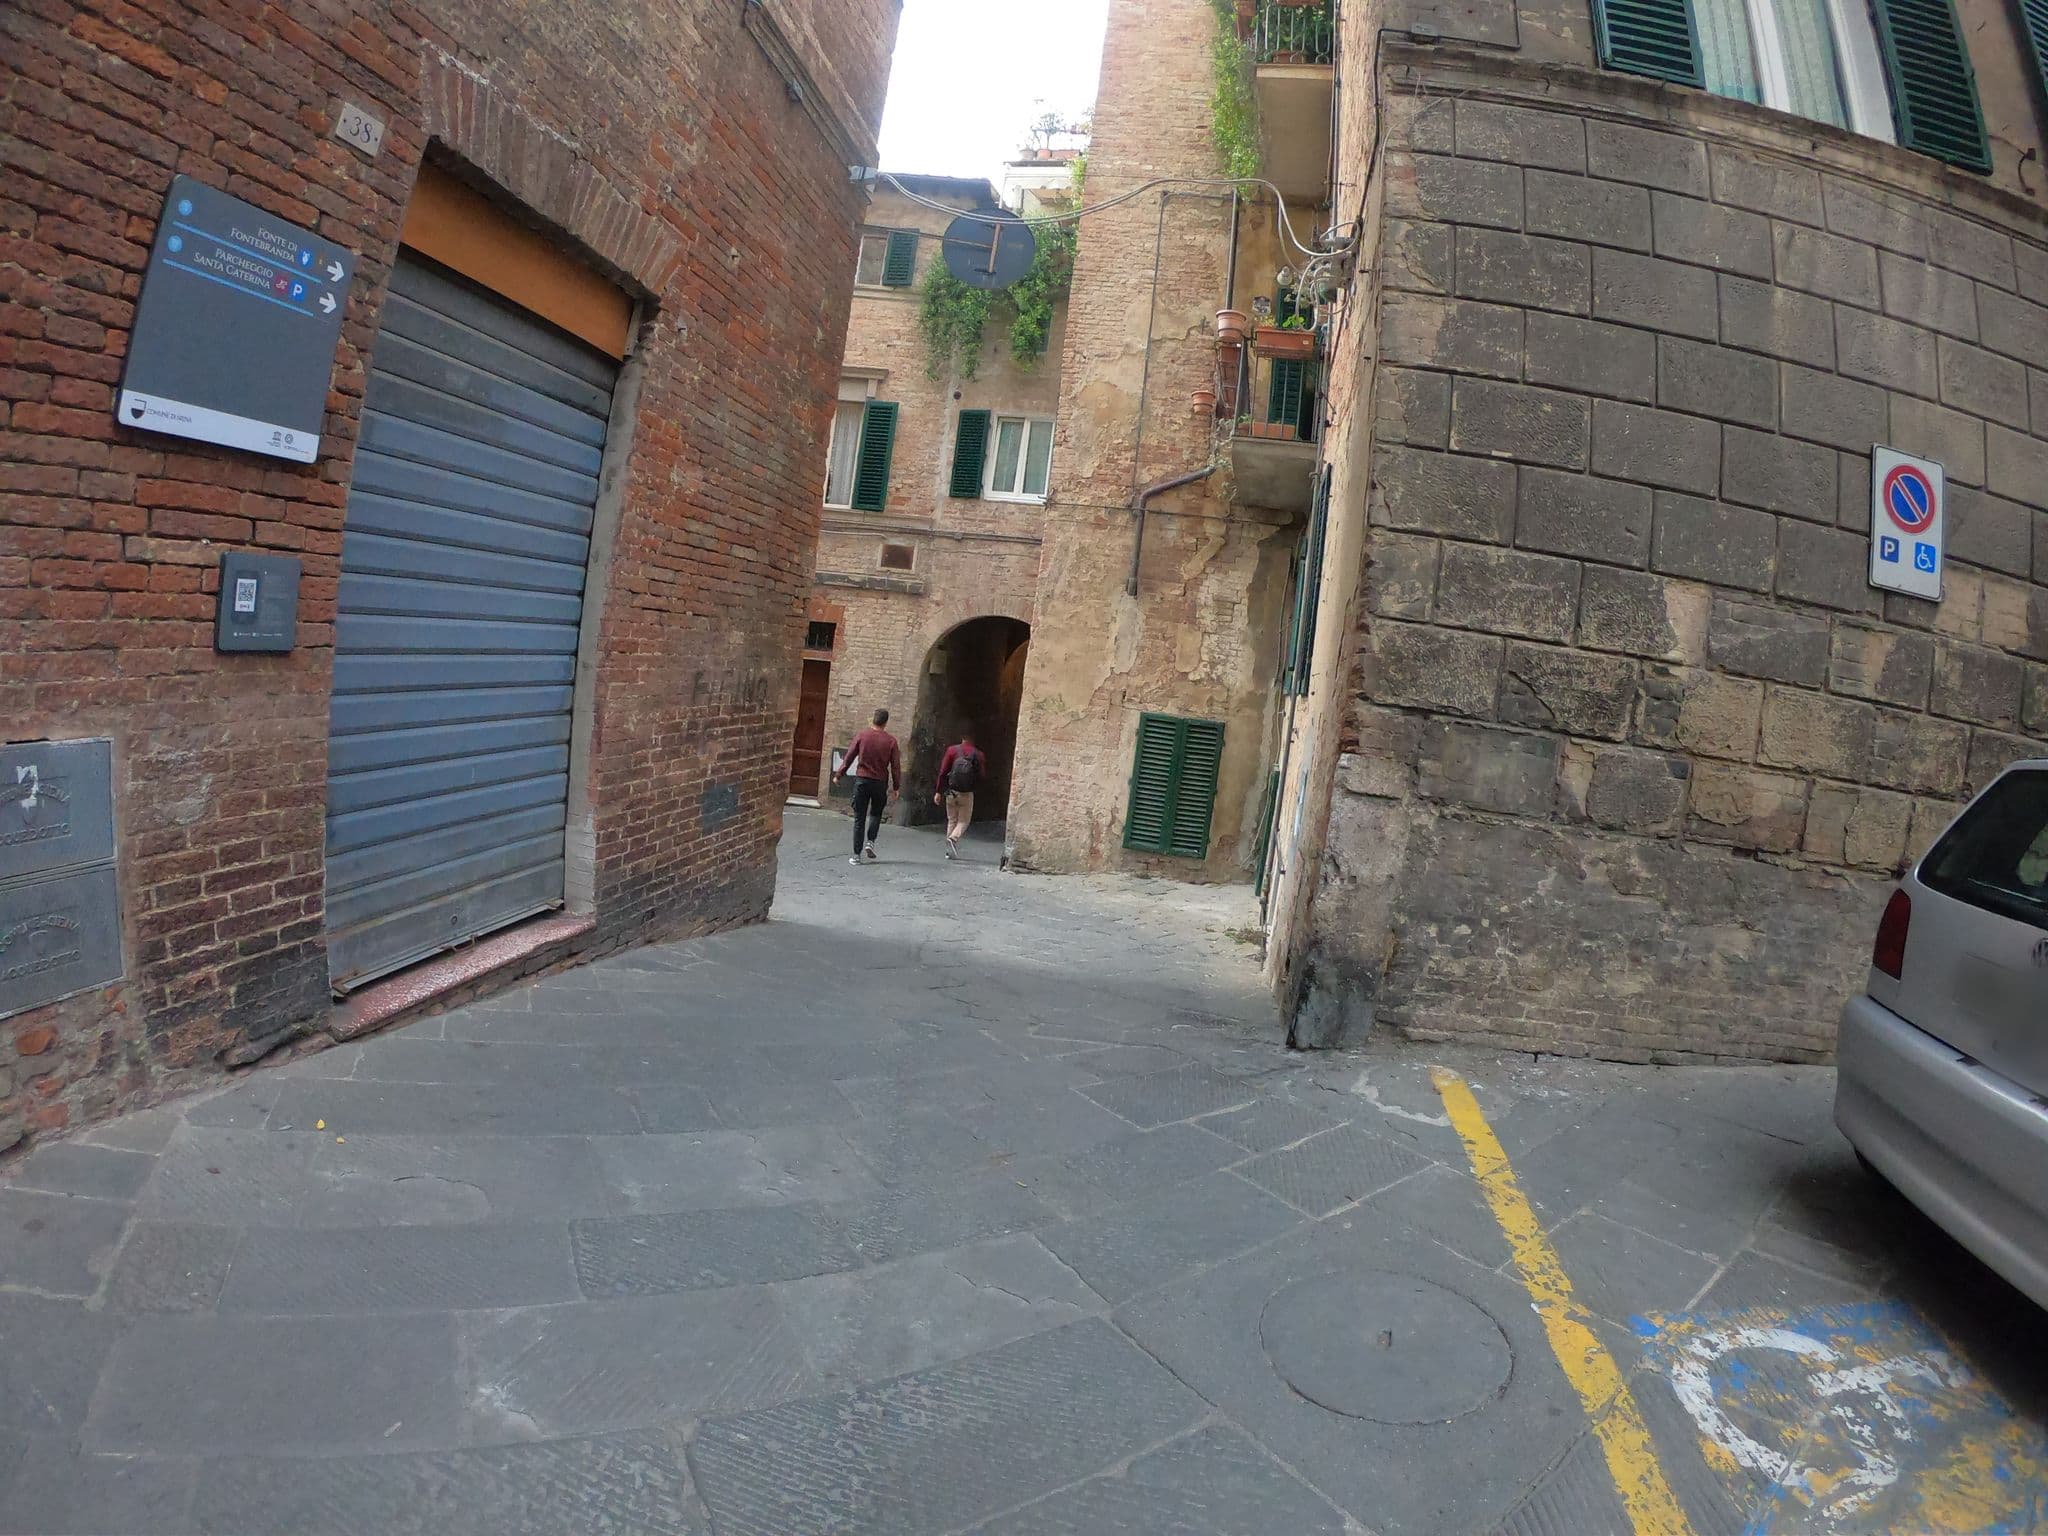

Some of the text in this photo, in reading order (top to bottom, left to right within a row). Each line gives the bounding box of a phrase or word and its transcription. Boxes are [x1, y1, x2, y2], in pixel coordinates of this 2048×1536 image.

[350, 116, 372, 143] 38
[230, 227, 295, 262] FONTEBRANDA
[258, 227, 298, 251] FONTE DI
[193, 252, 271, 289] SANTA CATERINA
[215, 247, 274, 278] PARCHEGGIO
[1884, 540, 1895, 557] P
